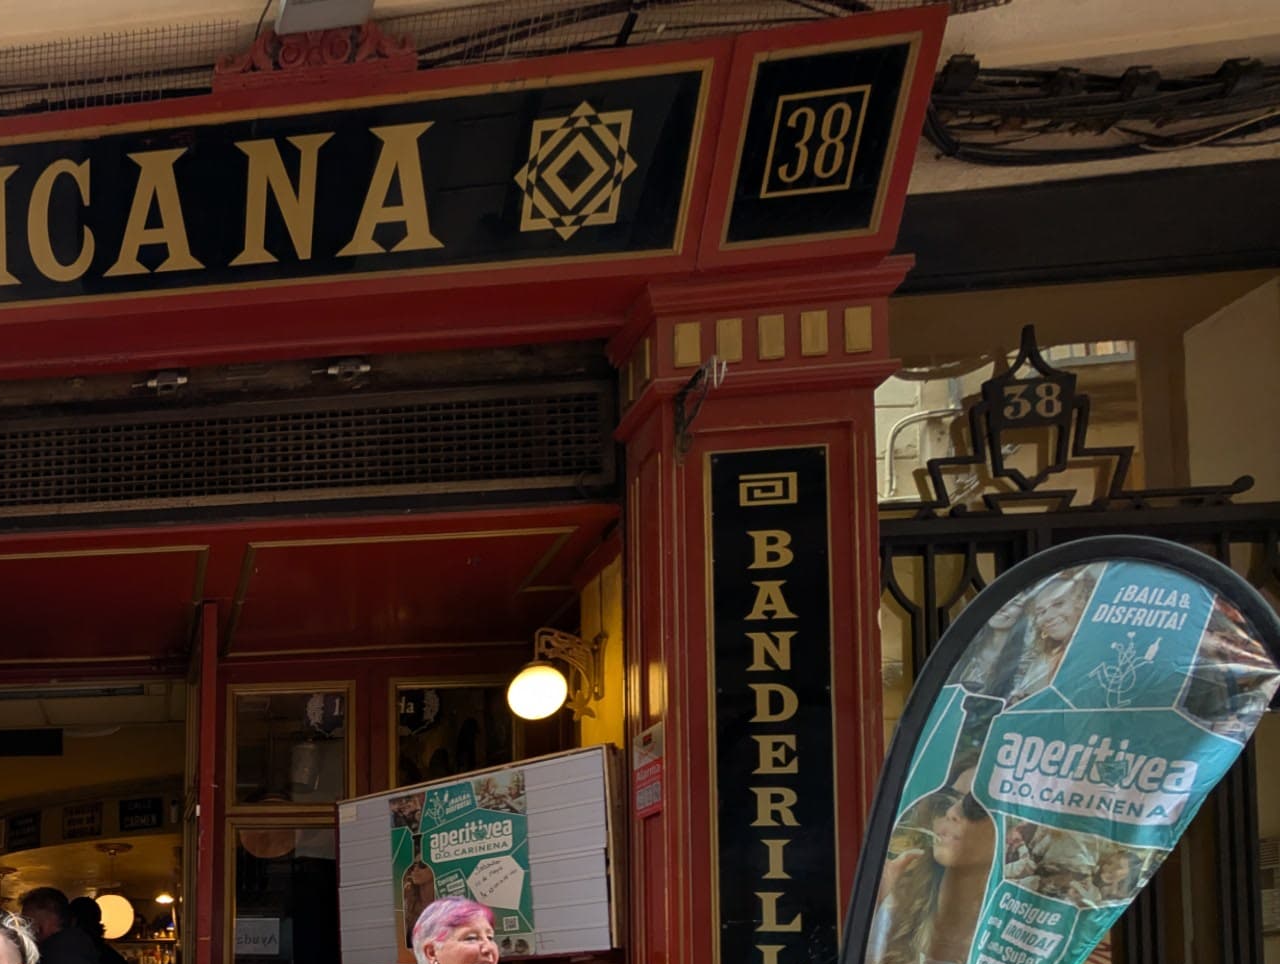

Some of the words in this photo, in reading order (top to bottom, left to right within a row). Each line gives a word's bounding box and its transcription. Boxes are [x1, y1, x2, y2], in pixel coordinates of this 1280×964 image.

[779, 101, 853, 184] 38
[1003, 382, 1062, 419] 38
[1091, 603, 1187, 631] DISFRUTA!
[999, 779, 1036, 799] D.O.
[999, 891, 1062, 926] Consigue
